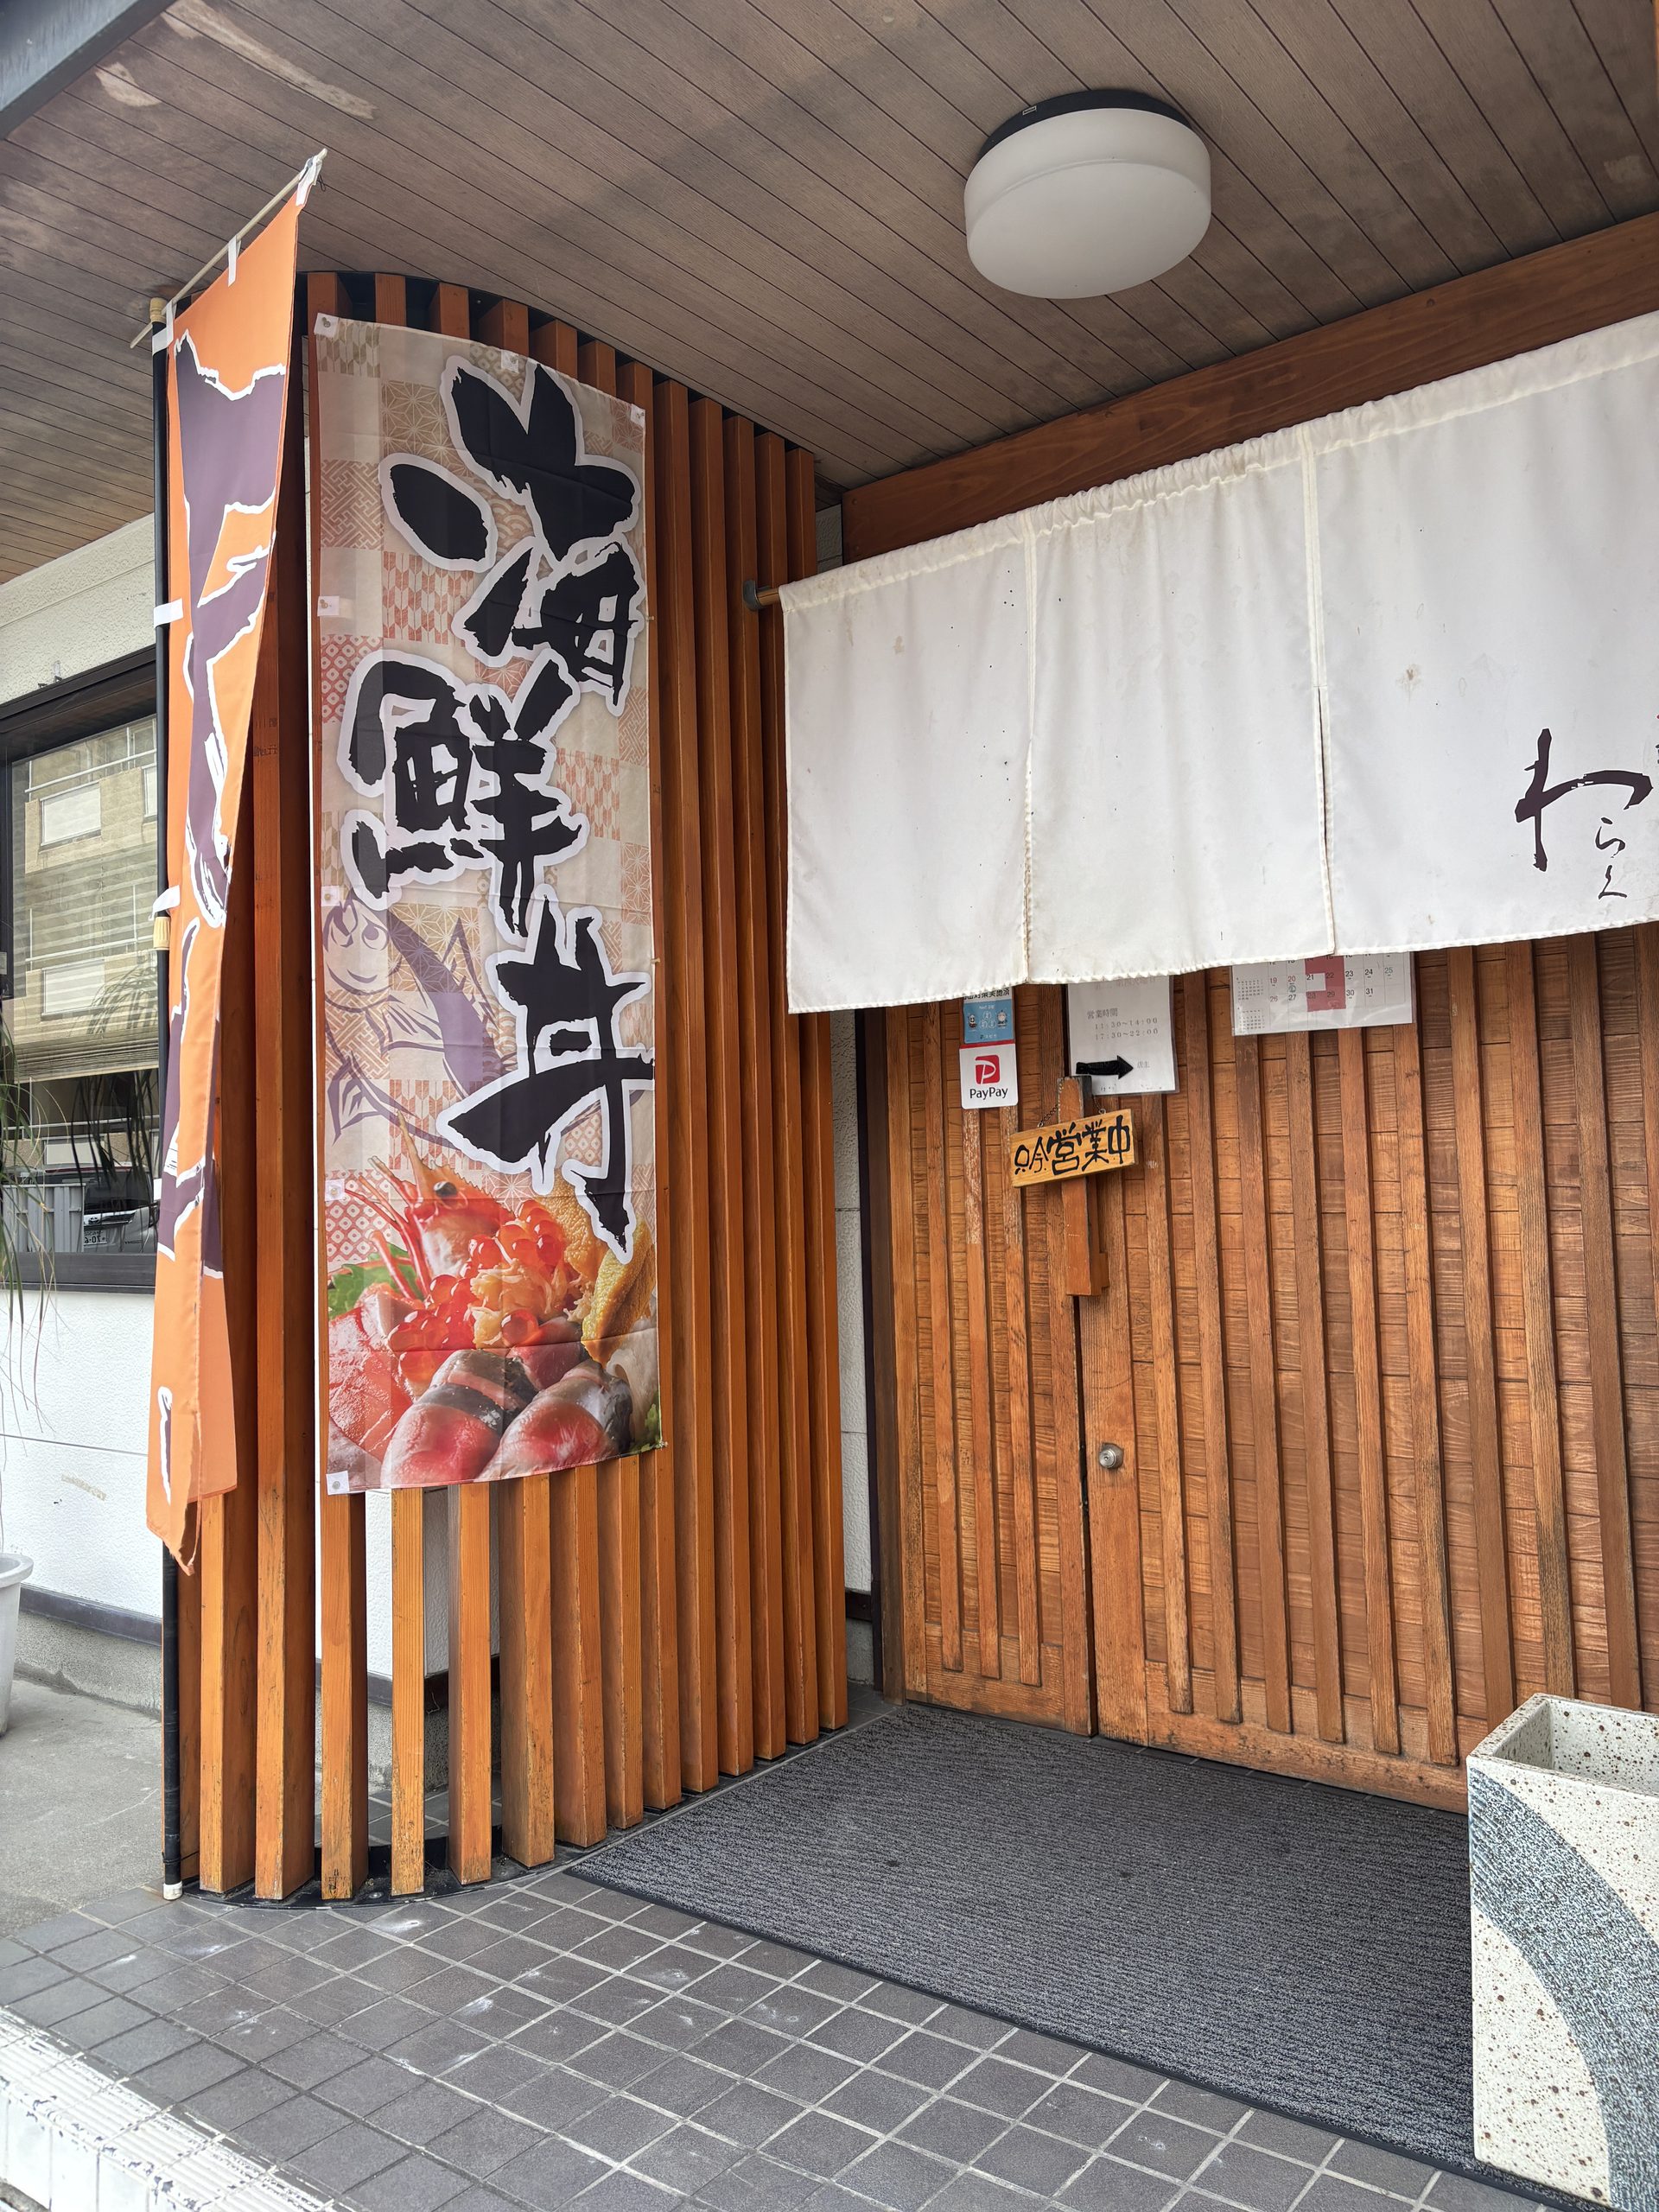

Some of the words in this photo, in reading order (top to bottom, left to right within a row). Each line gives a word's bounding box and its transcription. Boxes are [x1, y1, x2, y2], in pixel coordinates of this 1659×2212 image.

[343, 359, 654, 1258] 海鮮丼
[1515, 728, 1654, 899] わらく
[1086, 1007, 1118, 1020] 営業時間
[969, 1086, 1008, 1100] PayPay
[1014, 1115, 1130, 1175] 只今営業中
